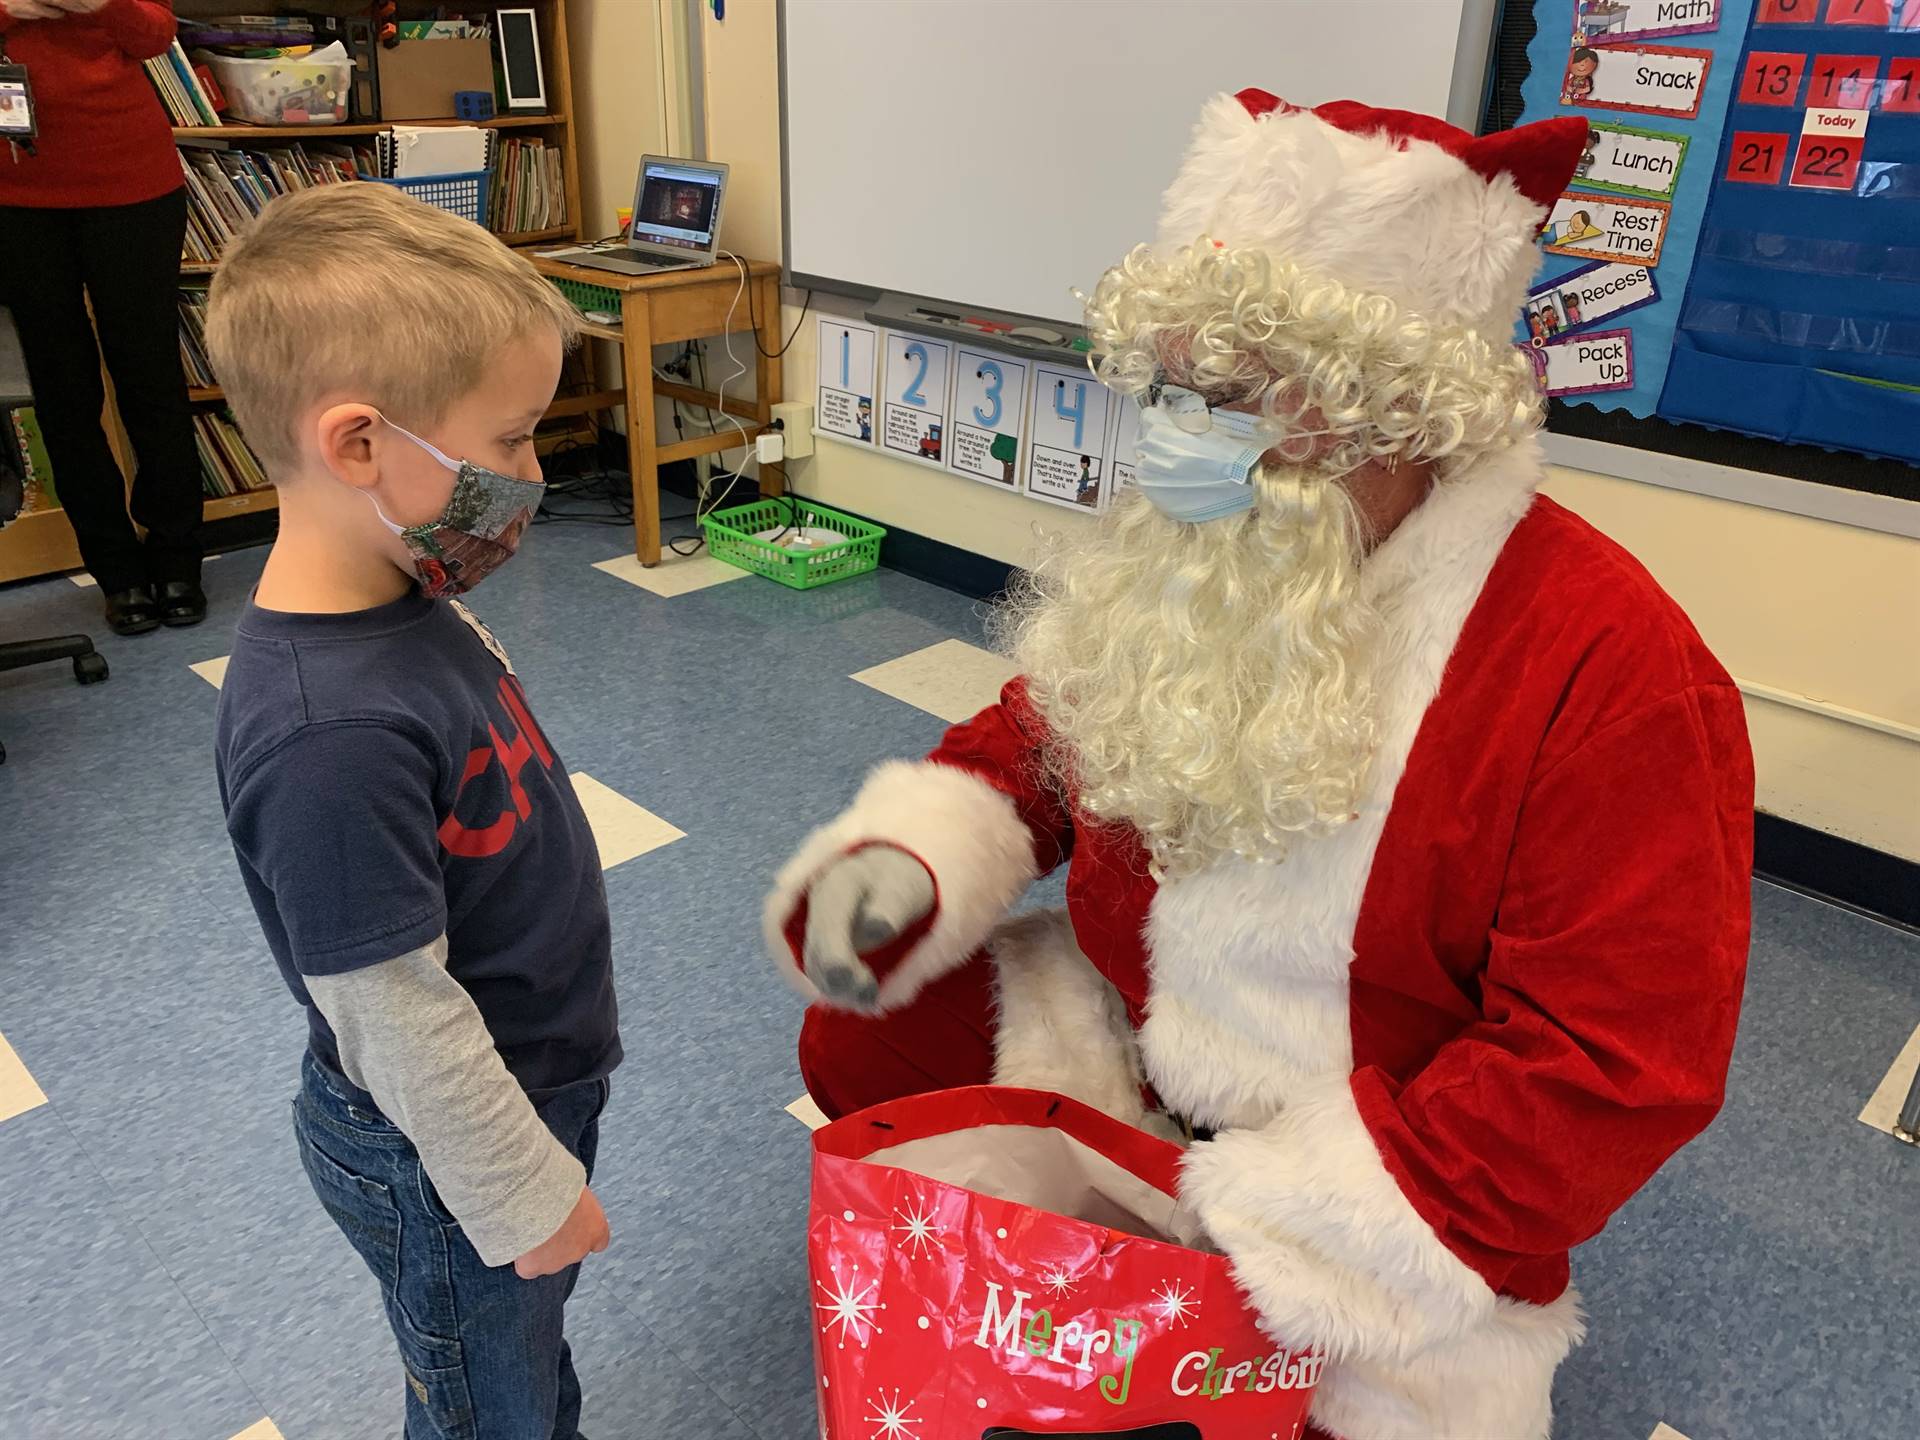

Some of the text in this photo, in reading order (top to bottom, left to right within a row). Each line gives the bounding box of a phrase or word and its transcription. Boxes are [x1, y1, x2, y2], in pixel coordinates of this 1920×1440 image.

[1657, 0, 1711, 21] Math
[1636, 67, 1697, 90] Snack
[1756, 64, 1920, 102] 13 14 1
[1817, 114, 1857, 130] Today
[1612, 148, 1673, 175] Lunch
[1738, 143, 1849, 177] 21 22
[1612, 210, 1660, 233] Rest
[1606, 231, 1653, 252] Time
[1582, 268, 1648, 306] Recess
[903, 342, 929, 407] 2
[1599, 363, 1624, 382] Up
[973, 360, 1004, 428] 3
[1055, 380, 1087, 449] 4
[957, 429, 974, 438] Around
[967, 440, 984, 449] around
[1033, 461, 1047, 469] Down
[1036, 454, 1051, 463] Down
[1053, 473, 1064, 481] how
[973, 1281, 1143, 1405] Merry
